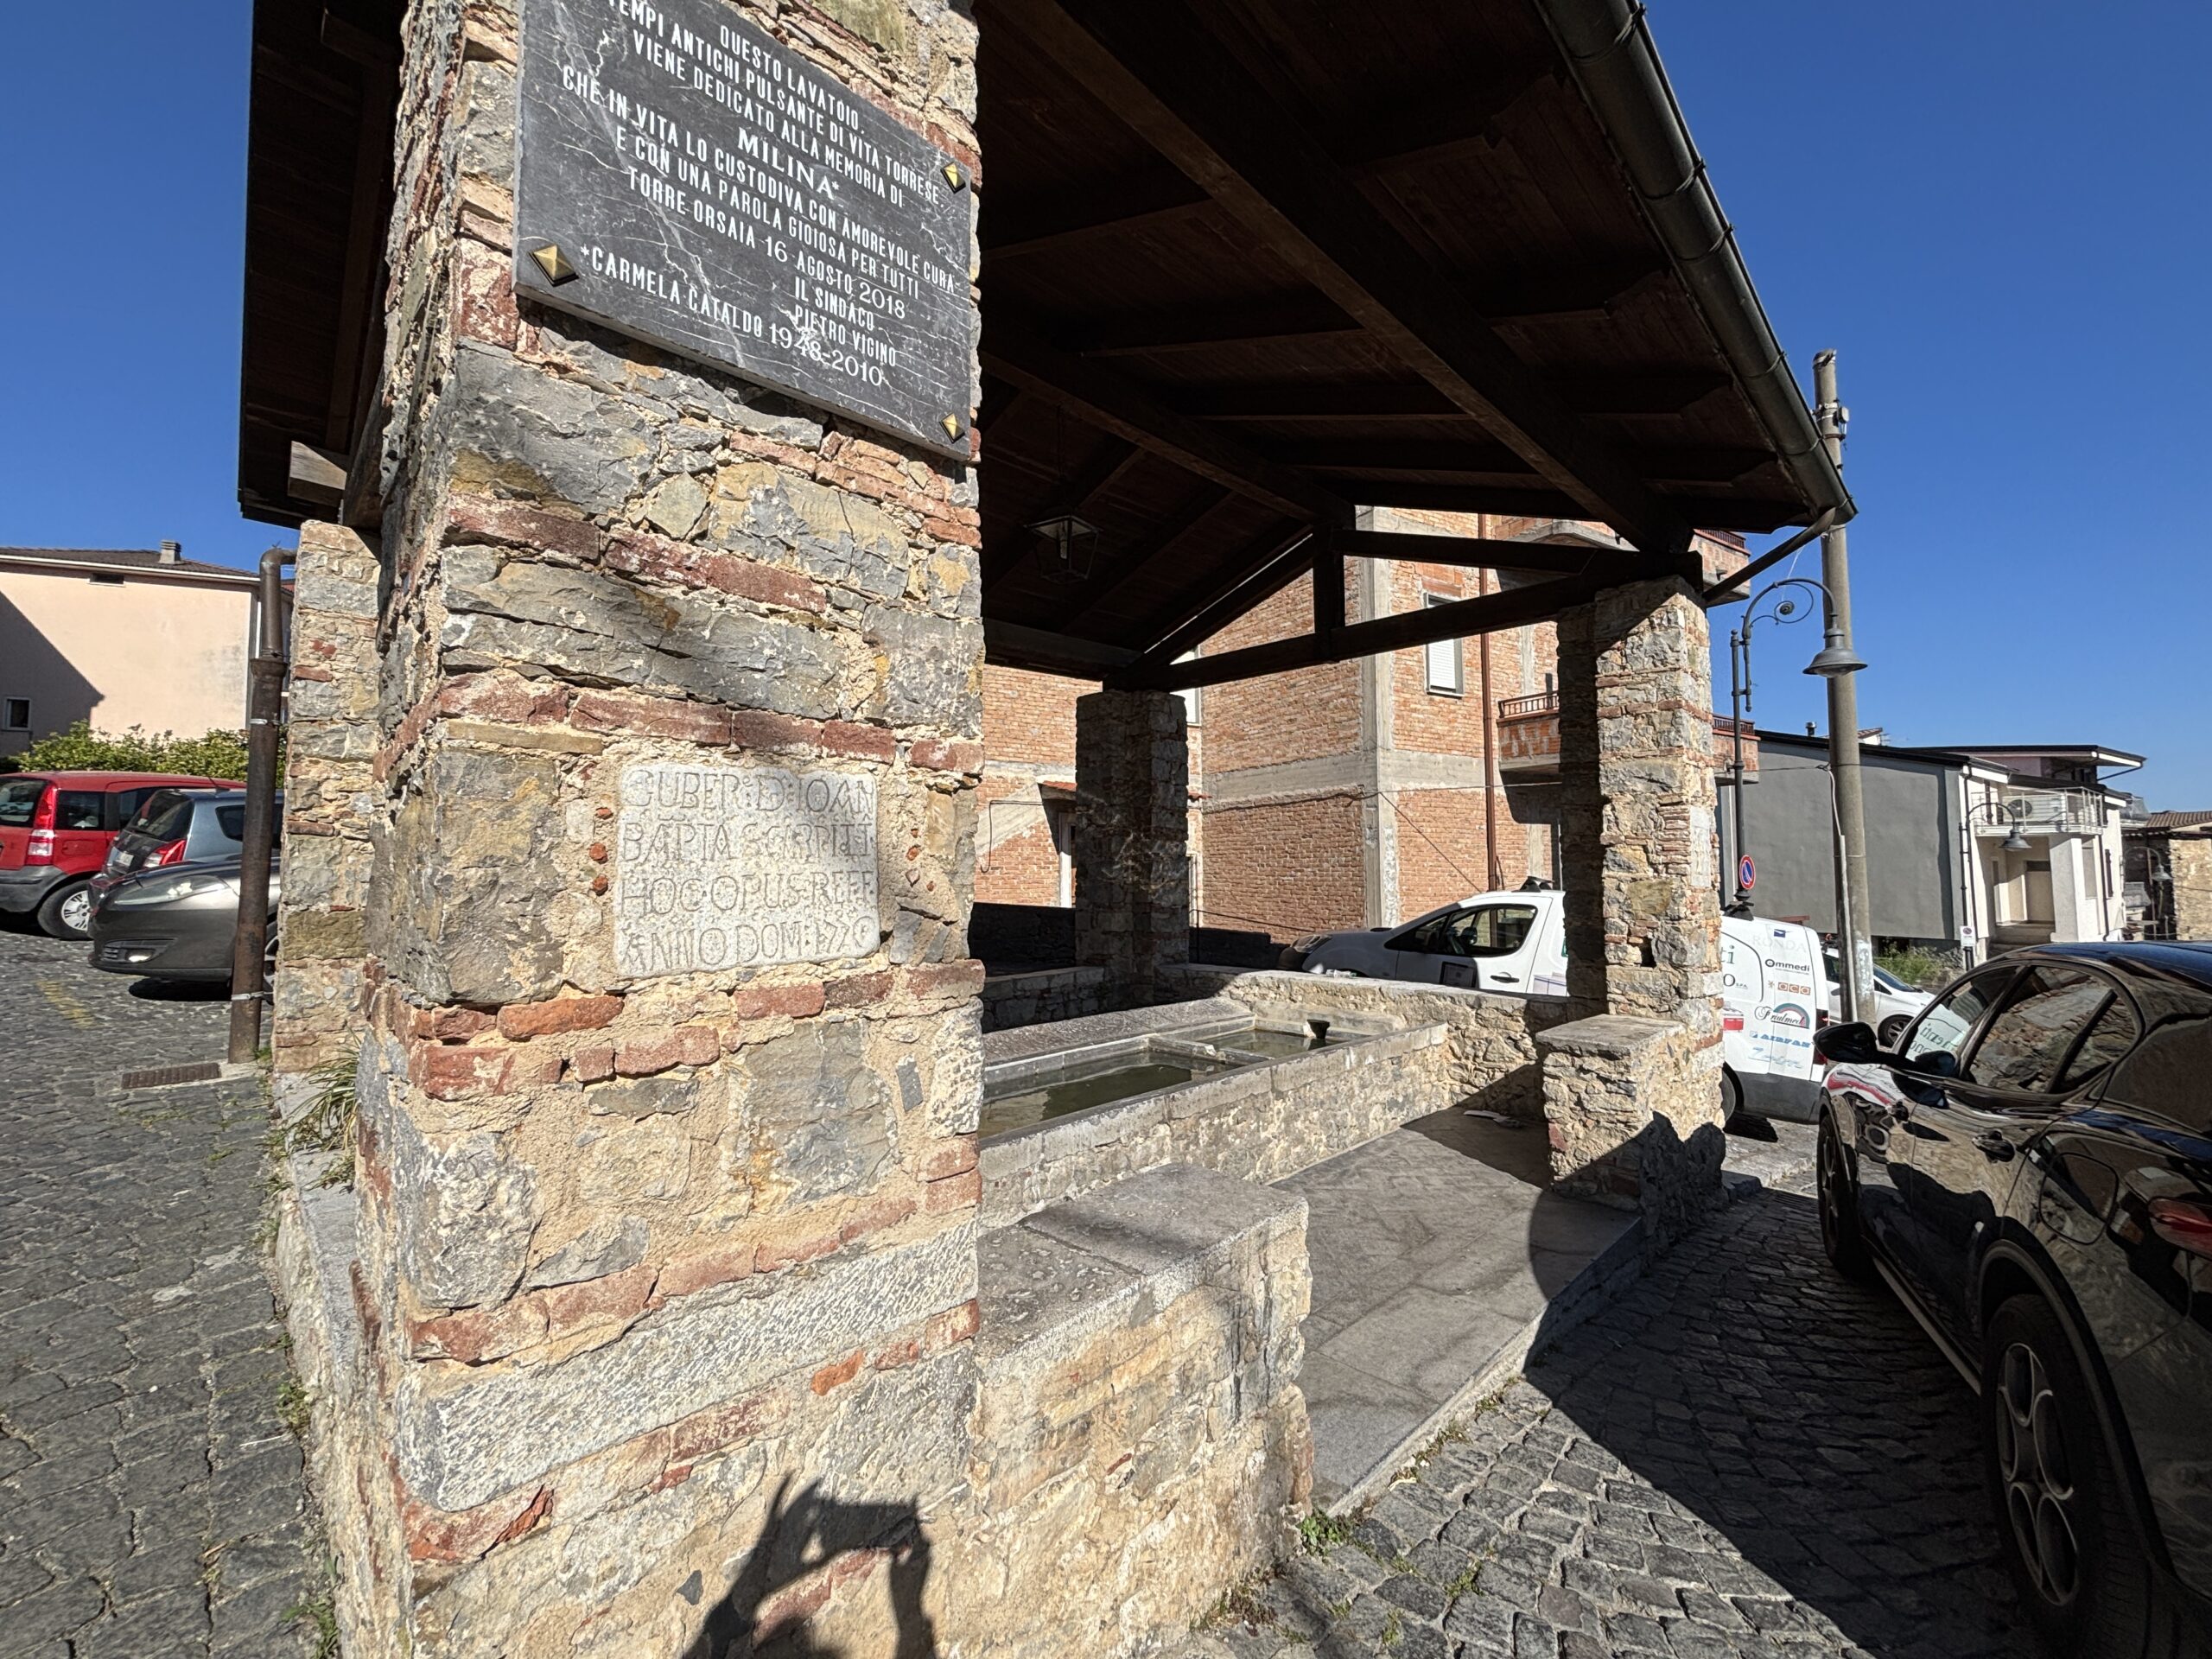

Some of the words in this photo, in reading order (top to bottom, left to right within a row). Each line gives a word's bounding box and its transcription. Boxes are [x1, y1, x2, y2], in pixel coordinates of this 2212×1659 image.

[609, 0, 664, 37] EMPI
[671, 22, 740, 84] ANTICHI
[747, 68, 824, 135] PULSANTE
[830, 121, 843, 147] DI
[849, 133, 880, 171] VITA
[885, 155, 944, 207] TORRESE.
[633, 29, 686, 81] VIENE
[694, 66, 774, 133] DEDICATO
[781, 119, 819, 160] ALLA
[825, 145, 886, 198] MEMORIA
[890, 184, 903, 208] DI
[721, 25, 781, 81] QUESTO
[563, 64, 601, 105] CHE
[609, 89, 627, 119] IN
[636, 103, 678, 148] VITA
[687, 131, 708, 162] LO
[715, 148, 804, 214] CUSTODIVA
[809, 199, 836, 232] CON
[842, 217, 918, 275] AMOREVOLE
[923, 261, 955, 294] CURA
[617, 125, 626, 151] E
[635, 136, 670, 174] CON
[678, 157, 712, 195] UNA
[719, 179, 782, 231] PAROLA
[789, 216, 846, 263] GIOIOSA
[851, 247, 877, 278] PER
[881, 264, 918, 300] TUTTI
[628, 165, 686, 215] TORRE
[694, 199, 756, 249] ORSAIA
[765, 236, 788, 262] 16
[797, 251, 853, 295] AGOSTO
[859, 283, 906, 319] 2018
[689, 289, 762, 337] CATALDO
[795, 276, 809, 302] IL
[815, 287, 874, 331] SINDACO
[795, 304, 846, 345] PIETRO
